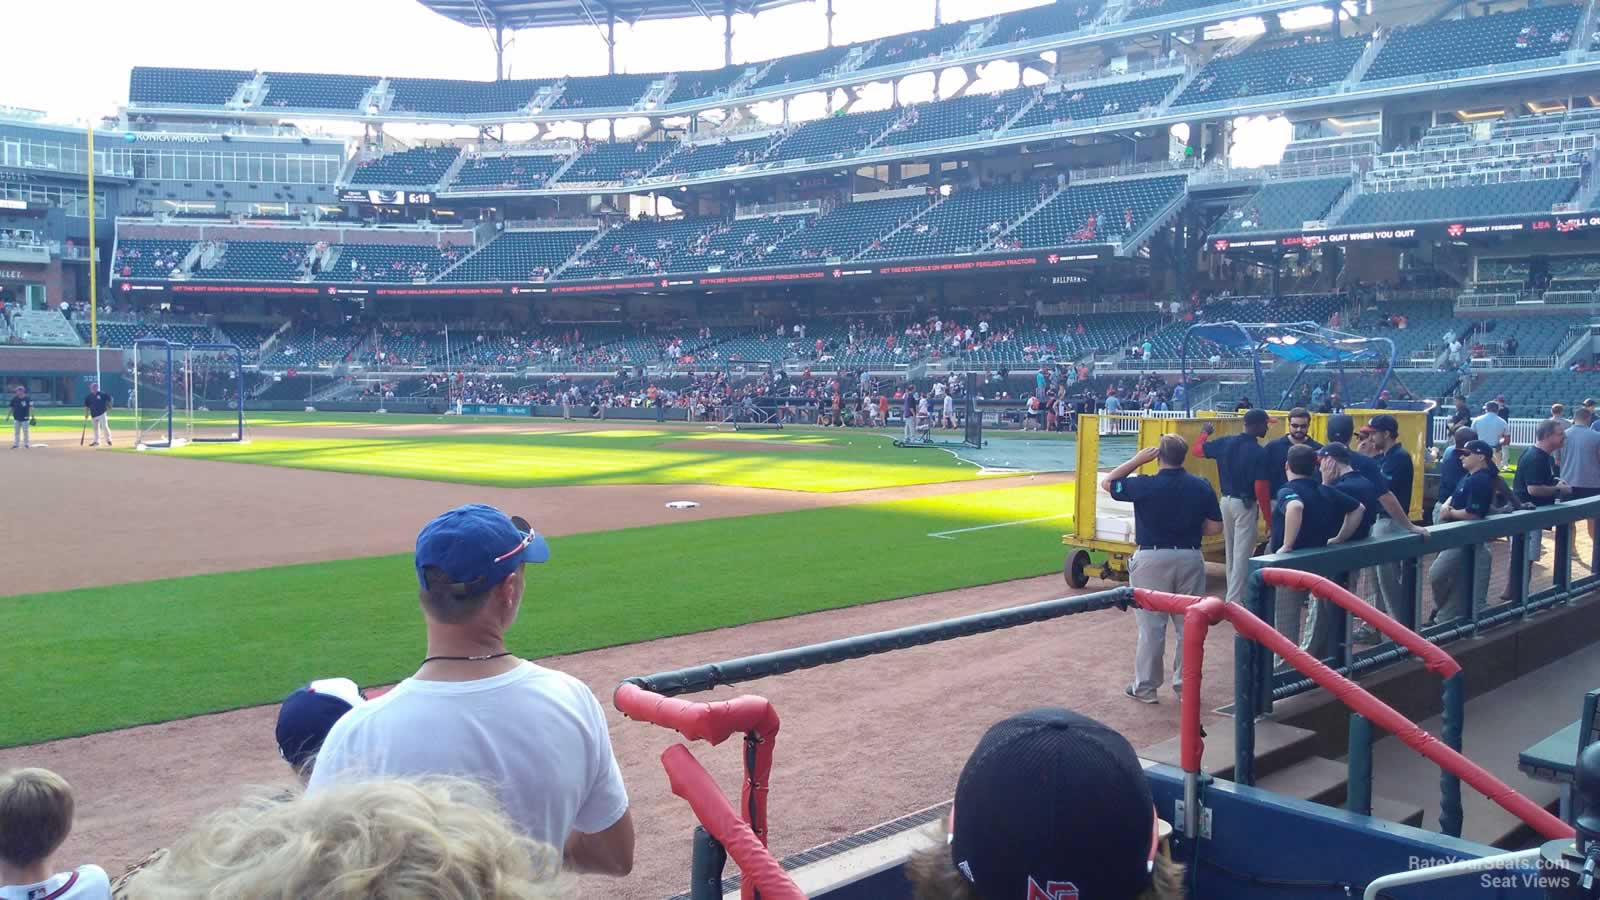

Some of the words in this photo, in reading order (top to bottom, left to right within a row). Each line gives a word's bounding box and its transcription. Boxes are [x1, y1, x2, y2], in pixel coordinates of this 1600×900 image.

[136, 134, 169, 142] KONICA
[171, 135, 209, 143] MINOLTA
[408, 193, 430, 204] 6:18
[1329, 234, 1348, 242] QUIT
[1349, 232, 1374, 241] WHEN
[1375, 231, 1393, 239] YOU
[1394, 229, 1415, 238] QUIT
